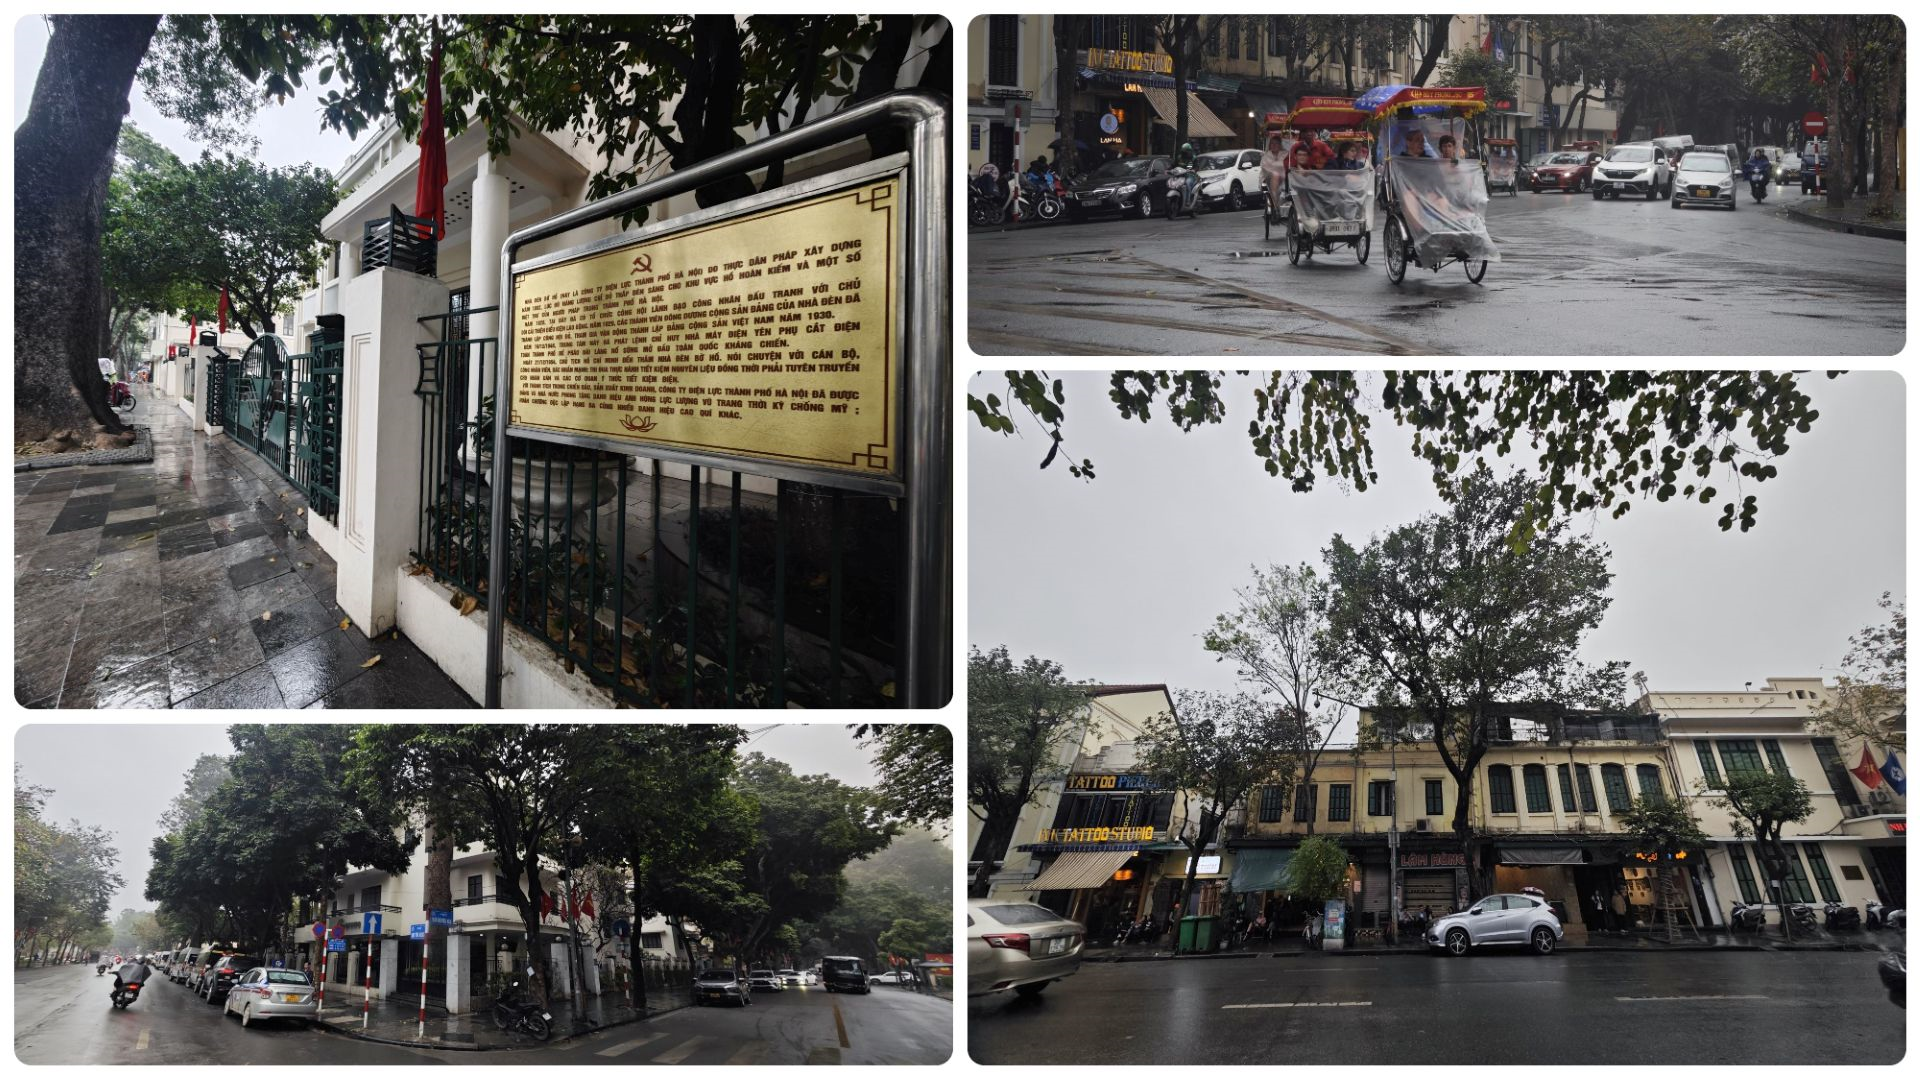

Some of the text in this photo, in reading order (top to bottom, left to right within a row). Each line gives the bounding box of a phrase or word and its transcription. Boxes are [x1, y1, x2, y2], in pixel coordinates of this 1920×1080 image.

[1109, 50, 1142, 70] TATTOO
[658, 272, 670, 281] PHỐ
[724, 260, 744, 270] THỰC
[749, 256, 766, 266] DÂN
[773, 250, 797, 262] PHÁP
[804, 246, 824, 256] XÂY
[831, 239, 862, 252] DỰNG
[648, 284, 664, 294] SÁNG
[668, 282, 681, 290] CHO
[686, 280, 700, 288] KHU
[704, 276, 718, 286] VỰC
[739, 269, 762, 279] HOÀN
[768, 263, 790, 275] KIẾM
[797, 260, 809, 270] VÀ
[816, 256, 838, 268] MỘT
[846, 250, 862, 263] SỐ
[637, 307, 646, 315] HỘI
[674, 302, 686, 311] ĐẠO
[693, 299, 712, 308] CÔNG
[719, 295, 740, 304] NHÂN
[748, 290, 764, 301] ĐẤU
[773, 288, 803, 298] TRANH
[812, 282, 828, 294] VỚI
[838, 277, 861, 290] CHỦ
[664, 312, 682, 320] ĐÔNG
[684, 311, 706, 319] DƯƠNG
[709, 308, 730, 317] CỘNG
[732, 304, 748, 314] SẢN
[751, 302, 774, 313] ĐẢNG
[777, 299, 795, 310] CỦA
[798, 298, 818, 308] NHÀ
[821, 294, 842, 306] ĐÈN
[846, 292, 861, 303] ĐÃ
[667, 322, 684, 331] ĐẢNG
[689, 321, 708, 330] CỘNG
[712, 318, 728, 328] SẢN
[732, 316, 748, 326] VIỆT
[754, 316, 774, 324] NAM
[780, 313, 801, 322] NĂM
[808, 310, 835, 320] 1930.
[685, 332, 699, 340] NHÀ
[706, 330, 722, 339] MÁY
[728, 329, 747, 339] ĐIỆN
[754, 328, 771, 336] YÊN
[779, 326, 798, 336] PHỤ
[806, 323, 826, 333] CẮT
[834, 321, 860, 332] ĐIỆN
[676, 344, 693, 352] TOÀN
[699, 341, 718, 350] QUỐC
[725, 340, 752, 350] KHÁNG
[760, 338, 790, 348] CHIẾN.
[658, 354, 671, 362] NHÀ
[695, 353, 704, 361] BỜ
[748, 350, 782, 362] CHUYỆN
[789, 350, 804, 360] VỚI
[812, 349, 833, 360] CÁN
[654, 365, 670, 374] KIỆM
[672, 364, 698, 372] NGUYÊN
[700, 364, 715, 374] LIỆU
[718, 363, 738, 372] ĐỒNG
[741, 363, 759, 372] THỜI
[762, 362, 782, 372] PHẢI
[786, 363, 816, 372] TUYÊN
[818, 360, 860, 372] TRUYỀN
[689, 386, 704, 396] ĐIỆN
[708, 387, 722, 396] LỰC
[725, 388, 751, 396] THÀNH
[754, 386, 772, 396] PHỐ
[775, 388, 788, 397] HÀ
[792, 389, 808, 399] NỘI
[812, 389, 826, 398] ĐÃ
[830, 390, 859, 401] ĐƯỢC
[660, 407, 674, 415] HIỆU
[700, 409, 712, 417] QUÍ
[719, 410, 742, 420] KHÁC.
[676, 398, 698, 406] LƯỢNG
[717, 399, 742, 408] TRANG
[748, 400, 766, 409] THỜI
[772, 400, 784, 410] KỲ
[790, 400, 824, 412] CHỐNG
[831, 403, 848, 413] MỸ
[1068, 776, 1117, 788] TATTOO
[1063, 827, 1109, 842] TATTOO
[1111, 826, 1154, 841] STUDIO
